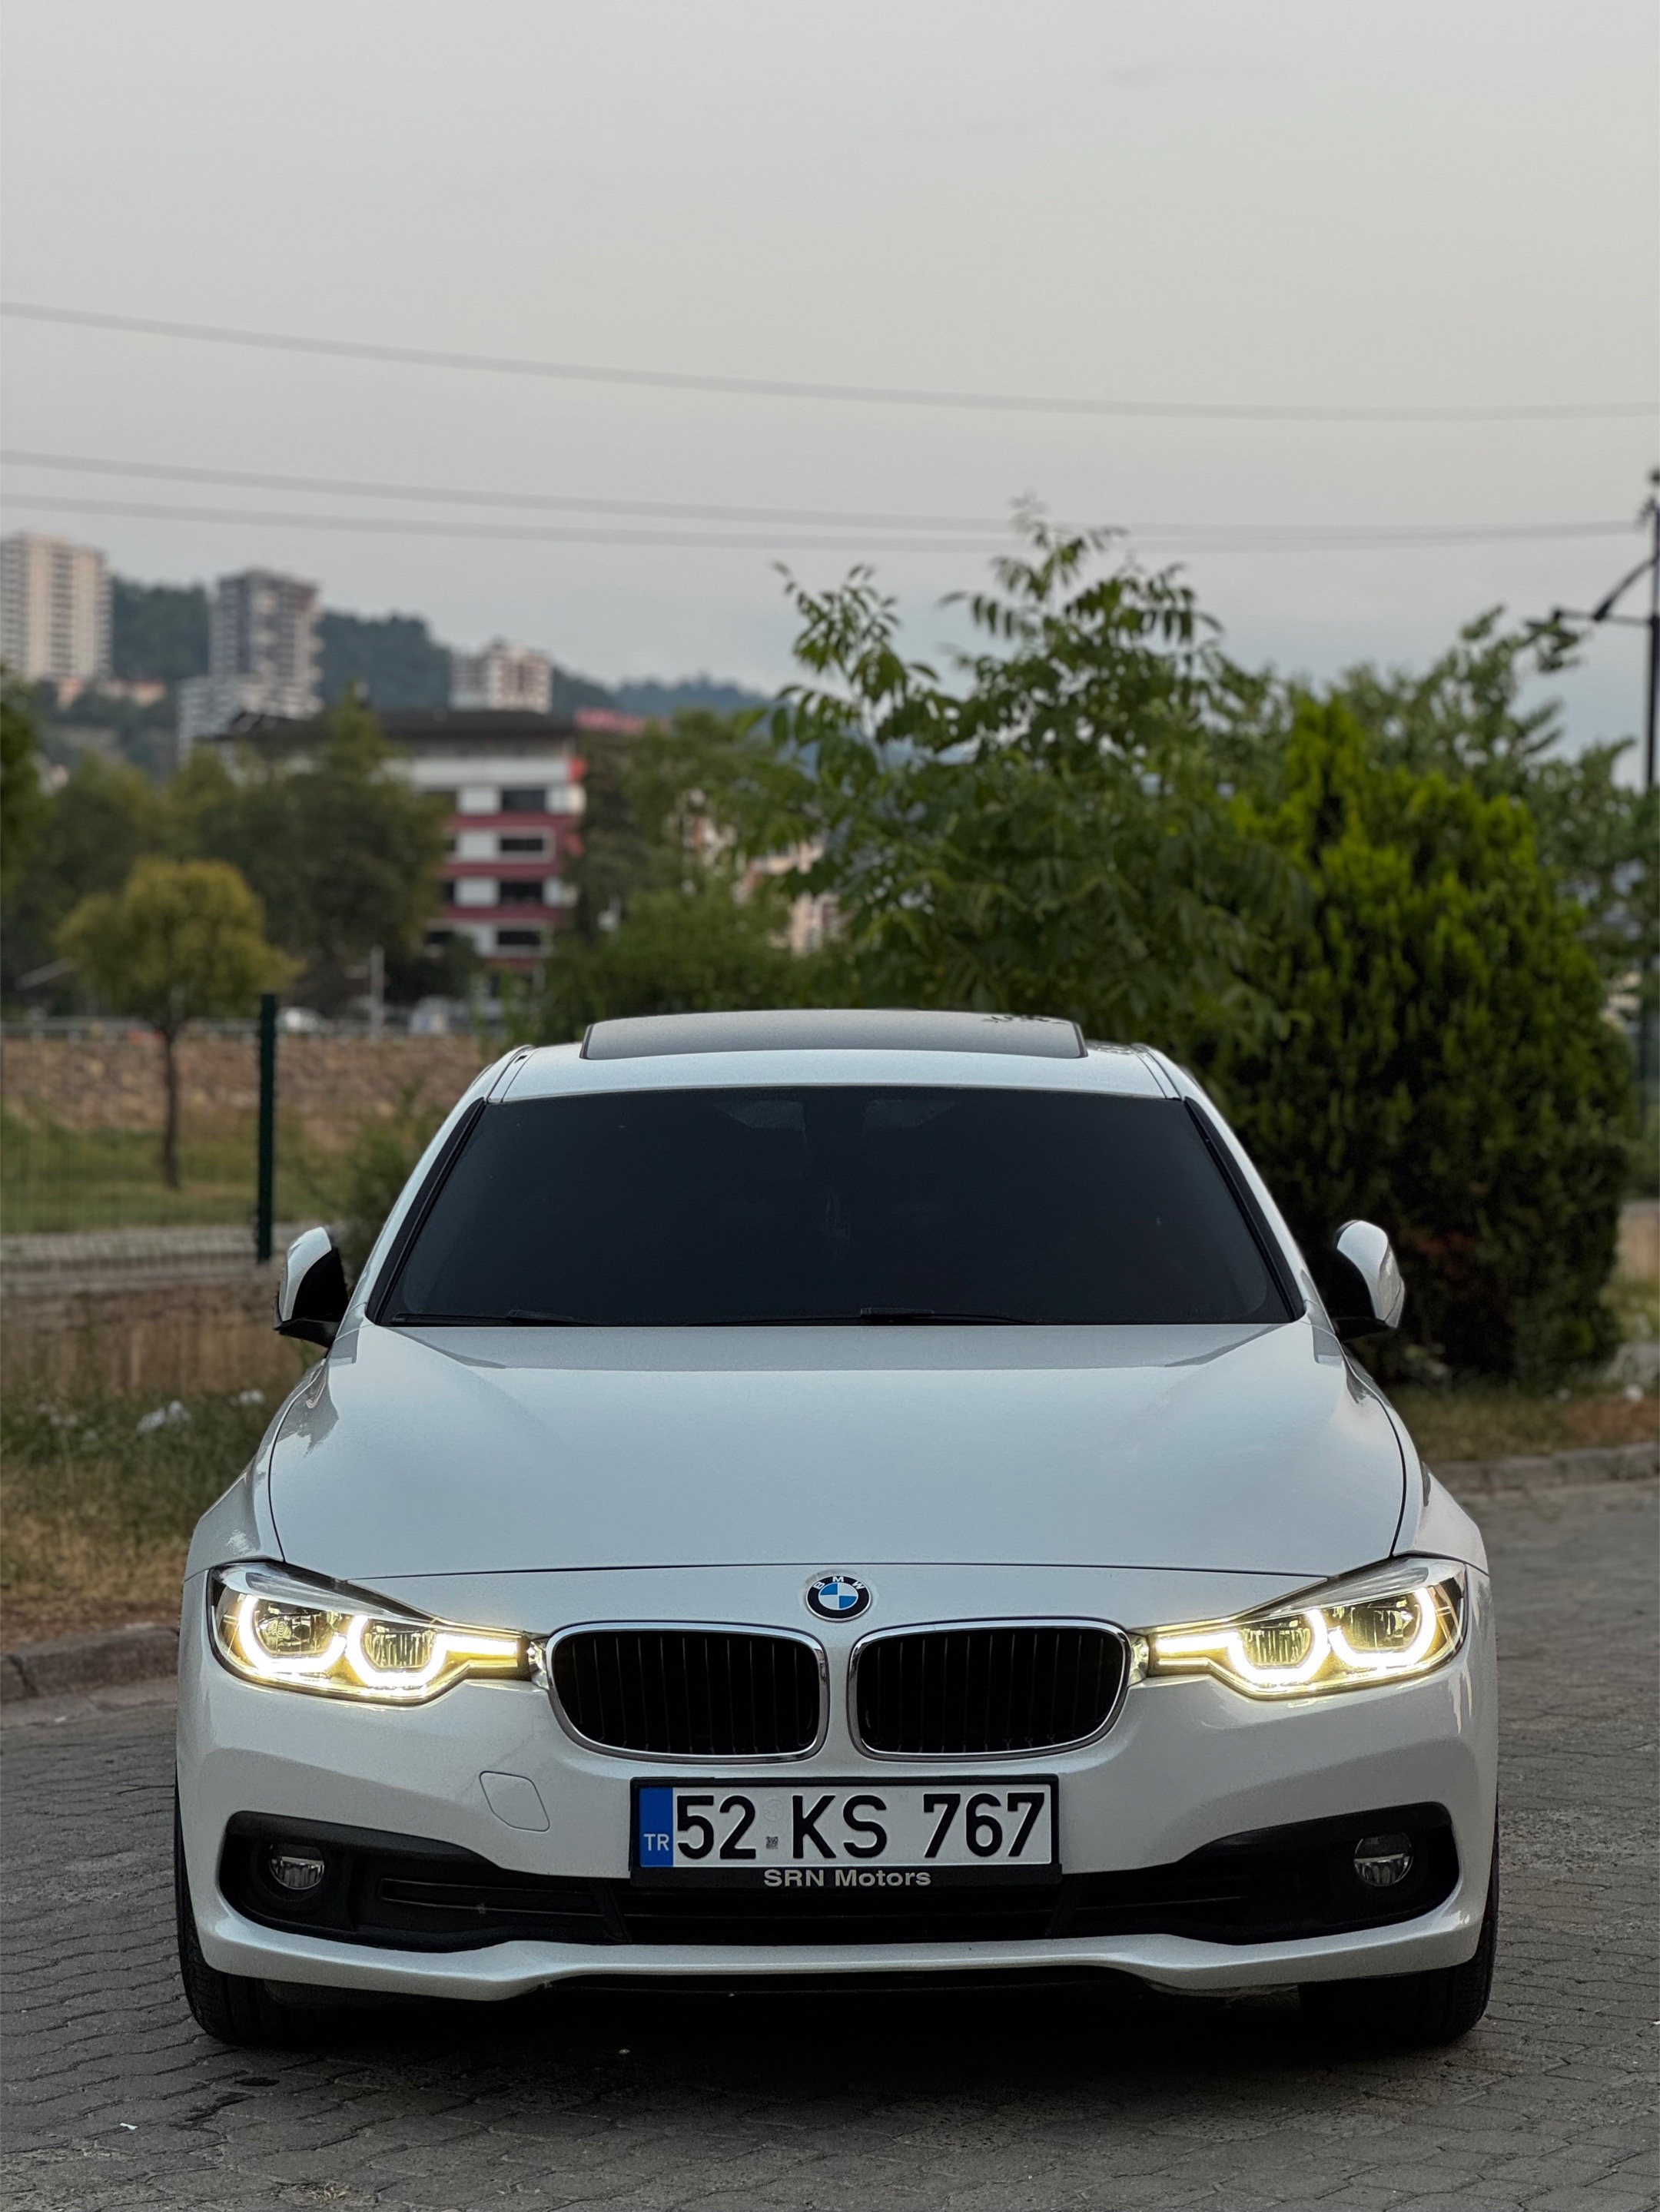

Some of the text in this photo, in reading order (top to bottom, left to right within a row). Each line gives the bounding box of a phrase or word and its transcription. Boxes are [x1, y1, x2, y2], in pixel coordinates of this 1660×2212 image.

[813, 1576, 865, 1590] BMW
[676, 1792, 1044, 1859] 52 KS 767
[644, 1833, 669, 1851] TR
[763, 1869, 931, 1887] SRN Motors
